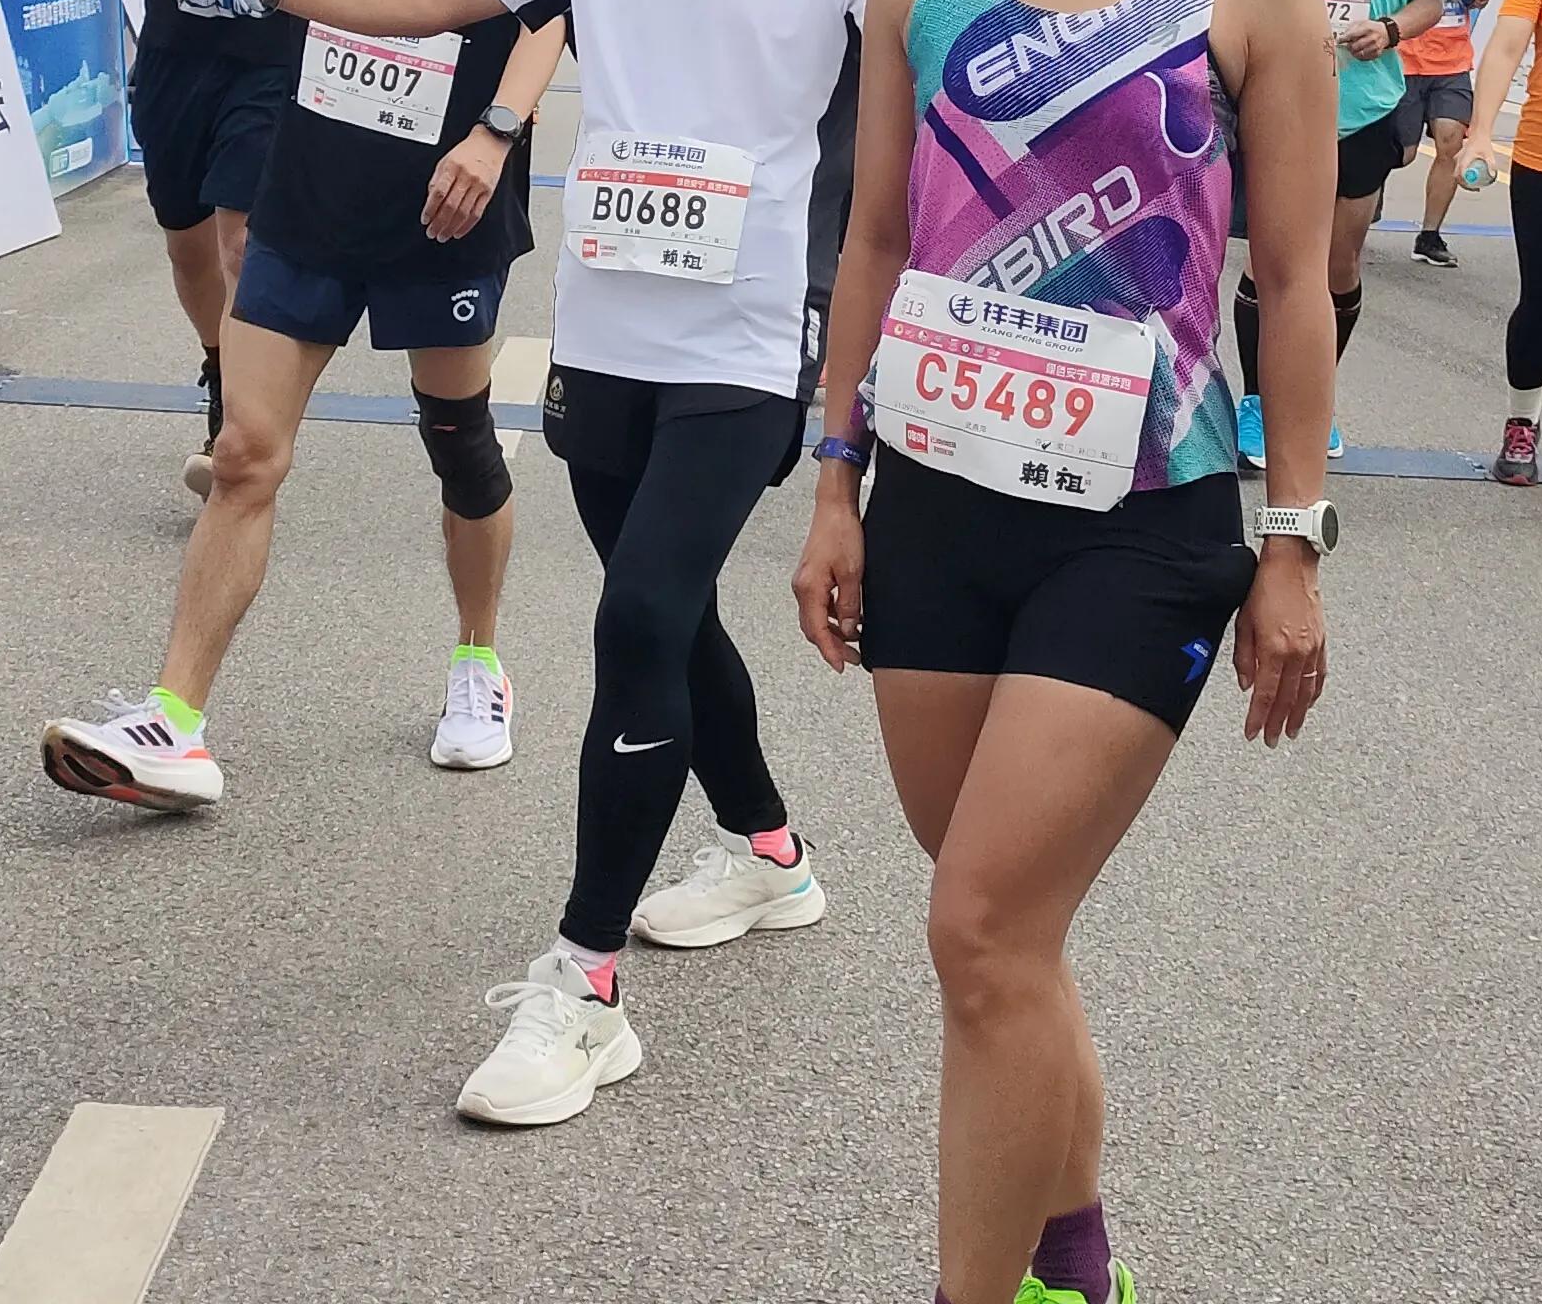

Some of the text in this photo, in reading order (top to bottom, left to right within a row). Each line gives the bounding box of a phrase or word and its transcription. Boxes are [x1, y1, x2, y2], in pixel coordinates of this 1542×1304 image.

[324, 46, 422, 97] C0607
[633, 140, 707, 164] 祥丰集团
[592, 186, 708, 230] B0688
[980, 326, 1084, 354] XIANG FENG GROUP
[982, 299, 1090, 344] 祥丰集团
[915, 352, 1095, 437] C5489
